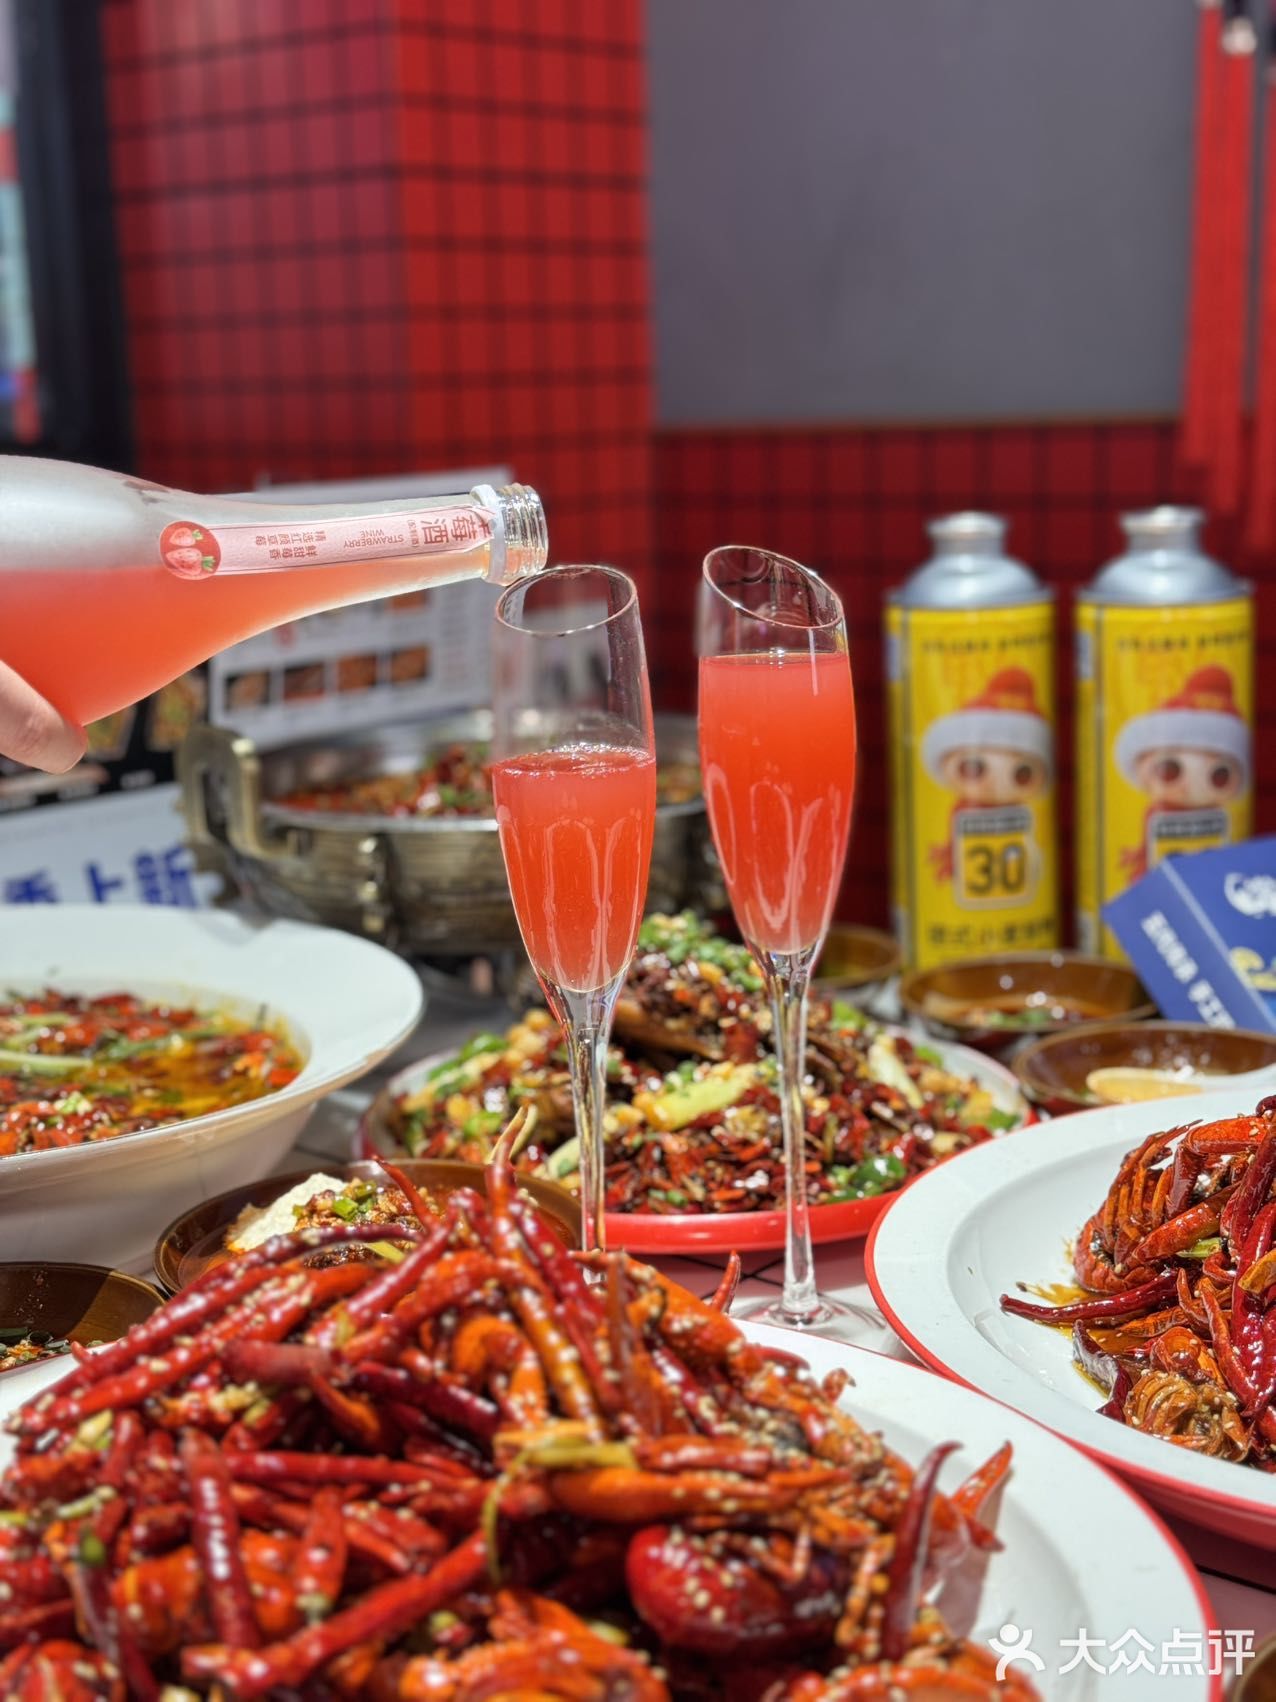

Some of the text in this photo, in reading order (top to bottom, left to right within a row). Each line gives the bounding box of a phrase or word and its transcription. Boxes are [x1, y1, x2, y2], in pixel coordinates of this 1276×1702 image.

[343, 534, 404, 549] STRAWBERRY
[360, 529, 385, 540] WINE
[966, 845, 1026, 896] 30
